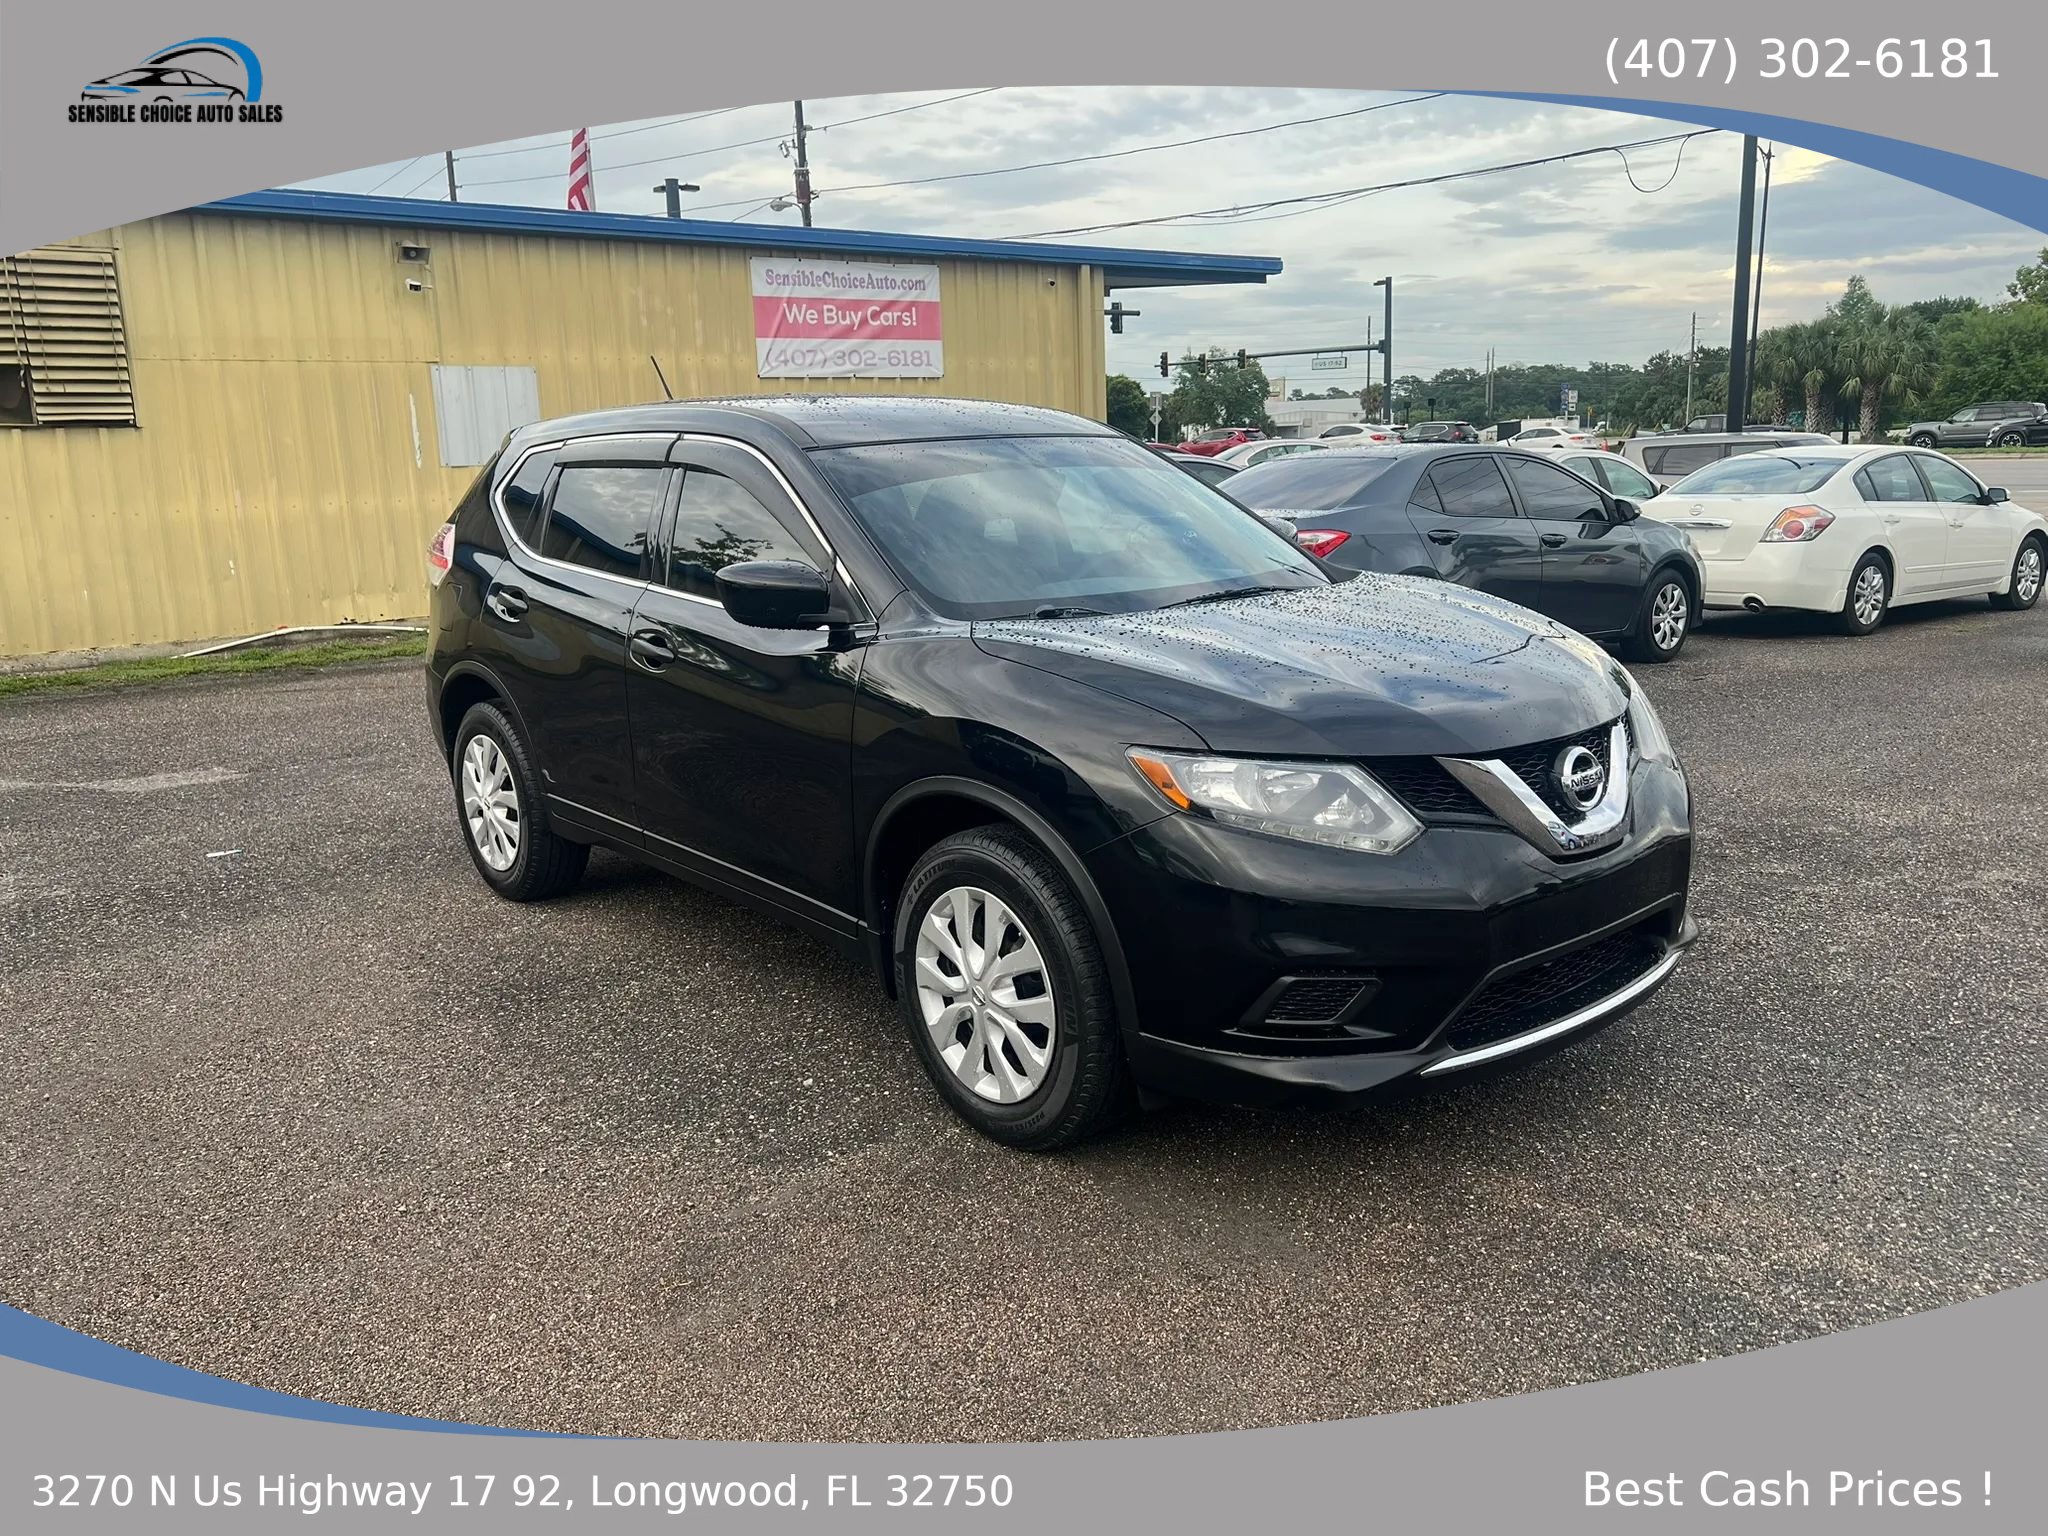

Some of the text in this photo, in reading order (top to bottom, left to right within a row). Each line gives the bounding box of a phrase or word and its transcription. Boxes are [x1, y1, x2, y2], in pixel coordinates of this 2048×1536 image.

[765, 268, 926, 292] SensibleChoiceAuto.com
[783, 303, 918, 331] We Buy Cars!
[765, 348, 933, 369] (407) 302-6181
